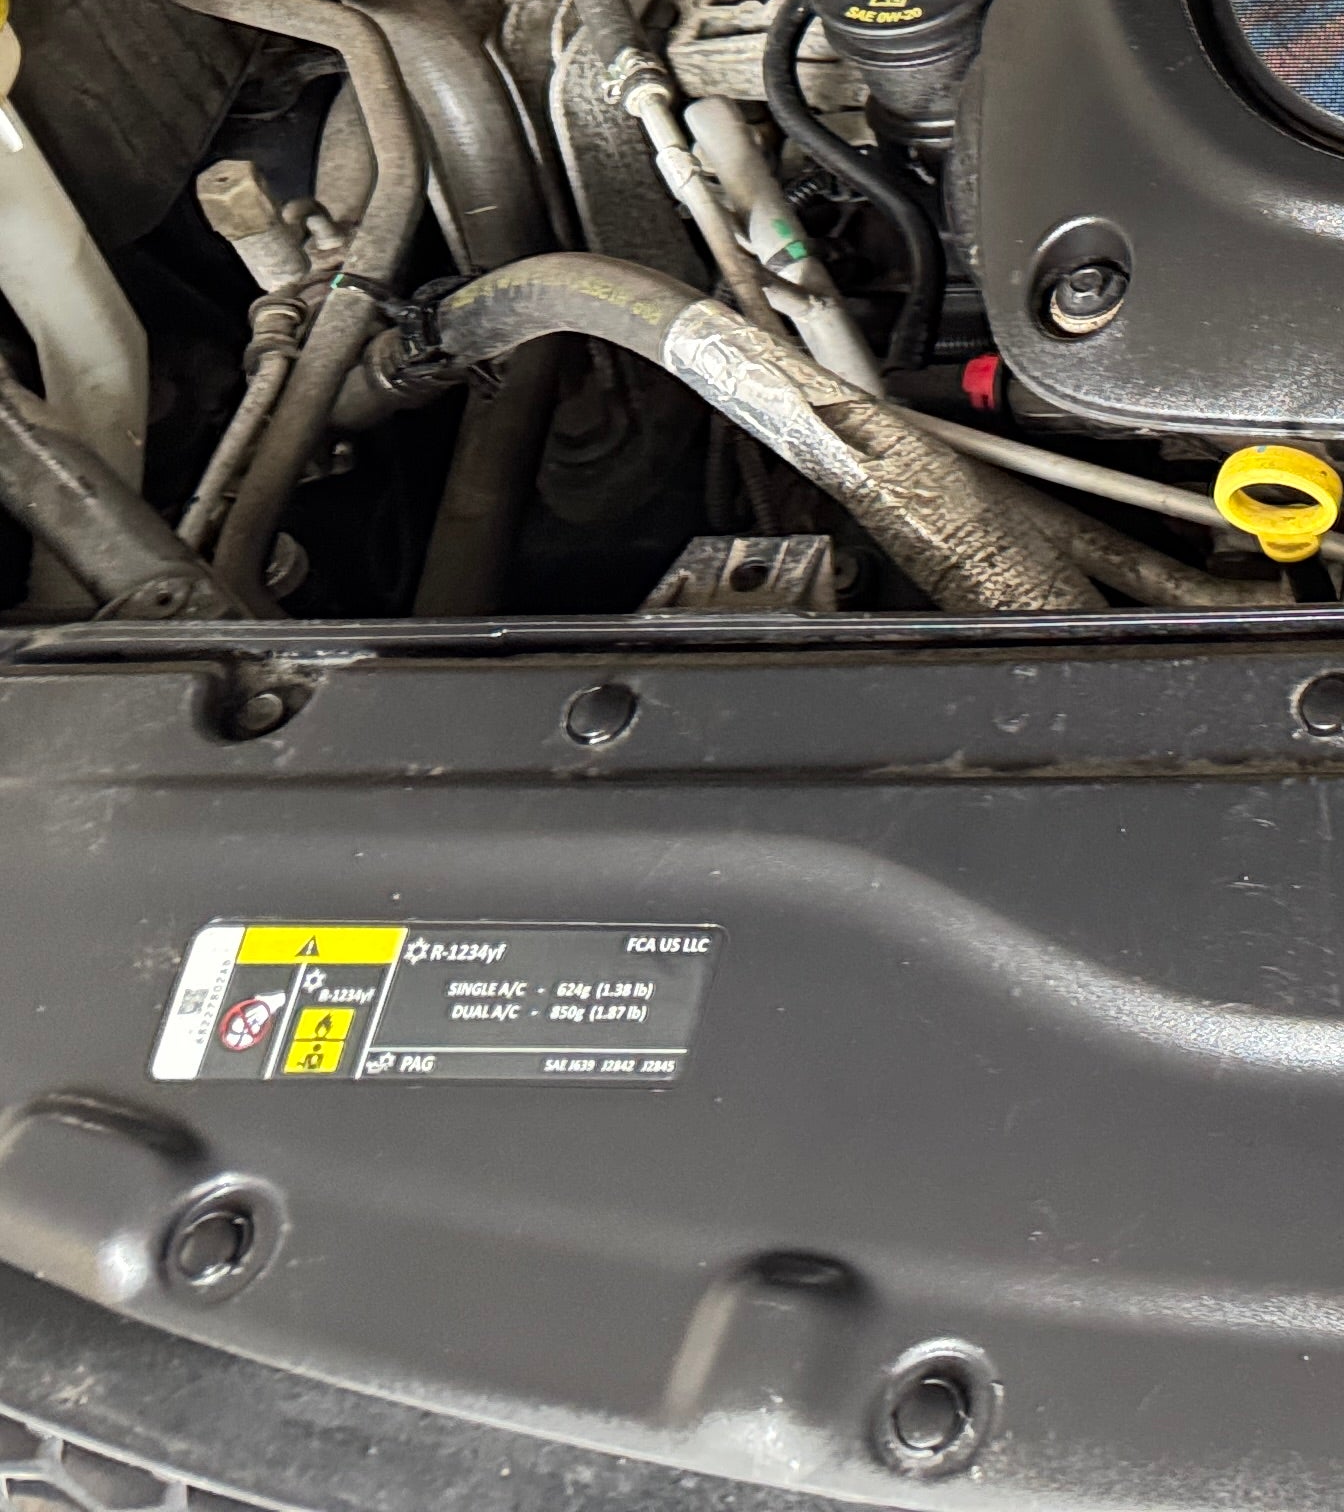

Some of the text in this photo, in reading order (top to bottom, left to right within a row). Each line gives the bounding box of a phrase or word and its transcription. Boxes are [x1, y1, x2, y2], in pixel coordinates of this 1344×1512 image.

[844, 6, 923, 24] SAE 0W-20
[430, 942, 507, 963] R-1234yf
[626, 937, 711, 953] FCA US LLC
[317, 987, 376, 1005] R-1234yf
[447, 982, 498, 997] SINGLE
[498, 981, 528, 998] A/C
[555, 982, 592, 1000] 624g
[595, 982, 633, 1000] (1.38
[632, 981, 656, 1000] lb)
[451, 1004, 492, 1020] DUAL
[491, 1004, 521, 1020] A/C
[549, 1005, 585, 1022] 850g
[589, 1004, 626, 1022] (1.87
[625, 1004, 648, 1022] lb)
[399, 1056, 436, 1072] PAG
[543, 1059, 676, 1072] SAE J639 J2842 J2845
